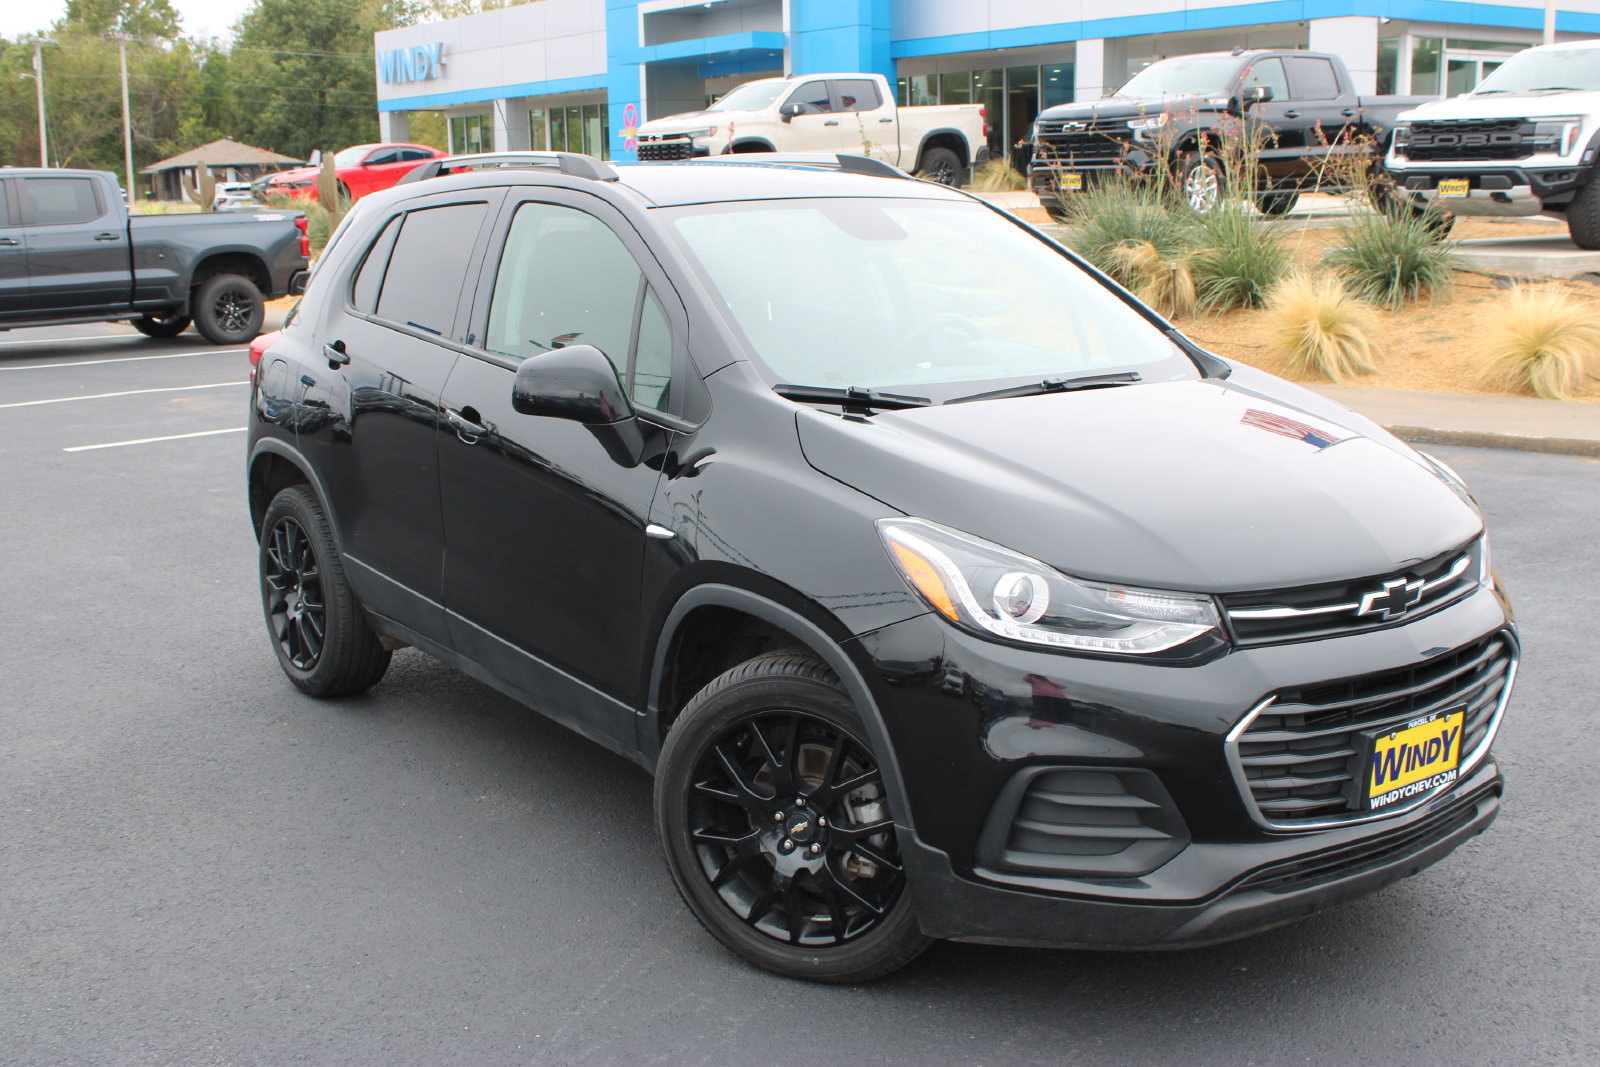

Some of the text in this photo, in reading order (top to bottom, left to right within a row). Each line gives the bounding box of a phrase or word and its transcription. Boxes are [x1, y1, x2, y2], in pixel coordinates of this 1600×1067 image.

[377, 42, 443, 84] WINDY
[1408, 133, 1522, 148] FORD
[1408, 716, 1428, 729] PURCELL
[1370, 769, 1457, 810] WINDYCHEV.COM
